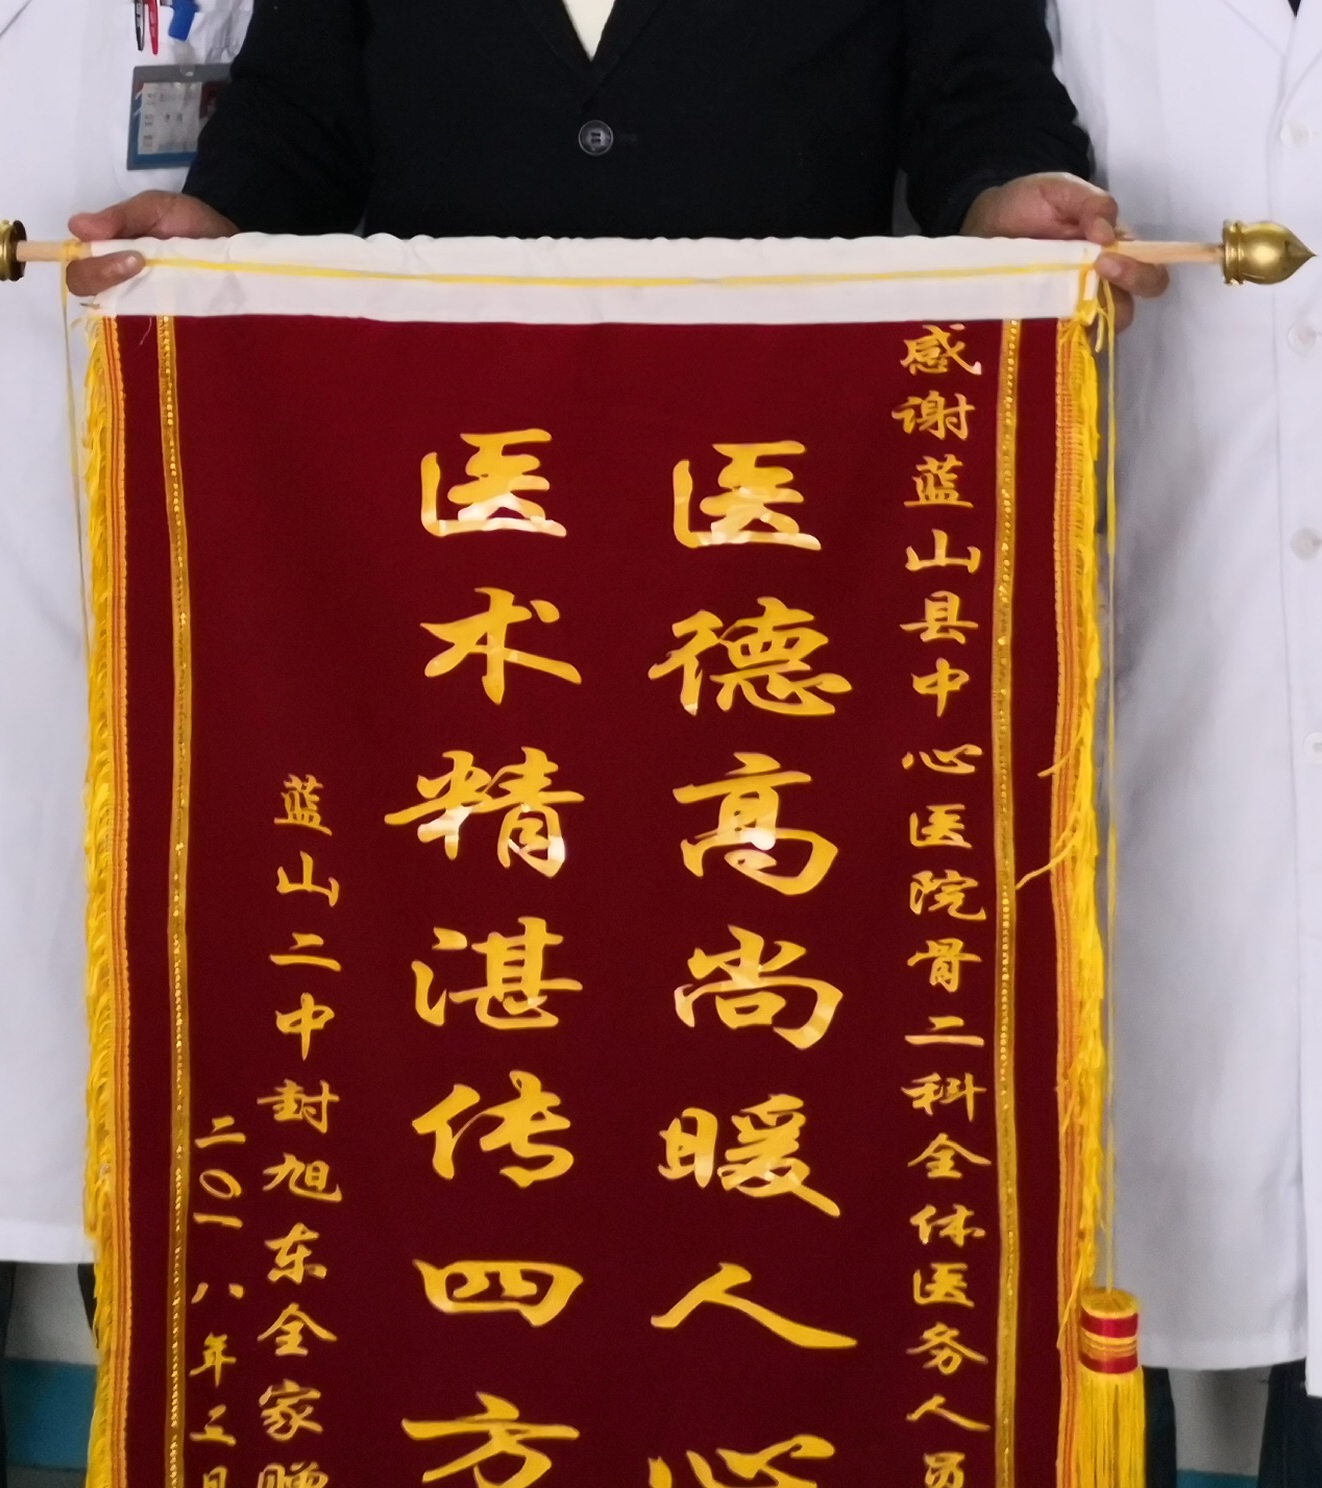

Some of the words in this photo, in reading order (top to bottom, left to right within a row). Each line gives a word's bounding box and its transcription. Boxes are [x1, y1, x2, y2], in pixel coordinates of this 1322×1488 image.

[384, 428, 585, 1488] 医术精湛传四方
